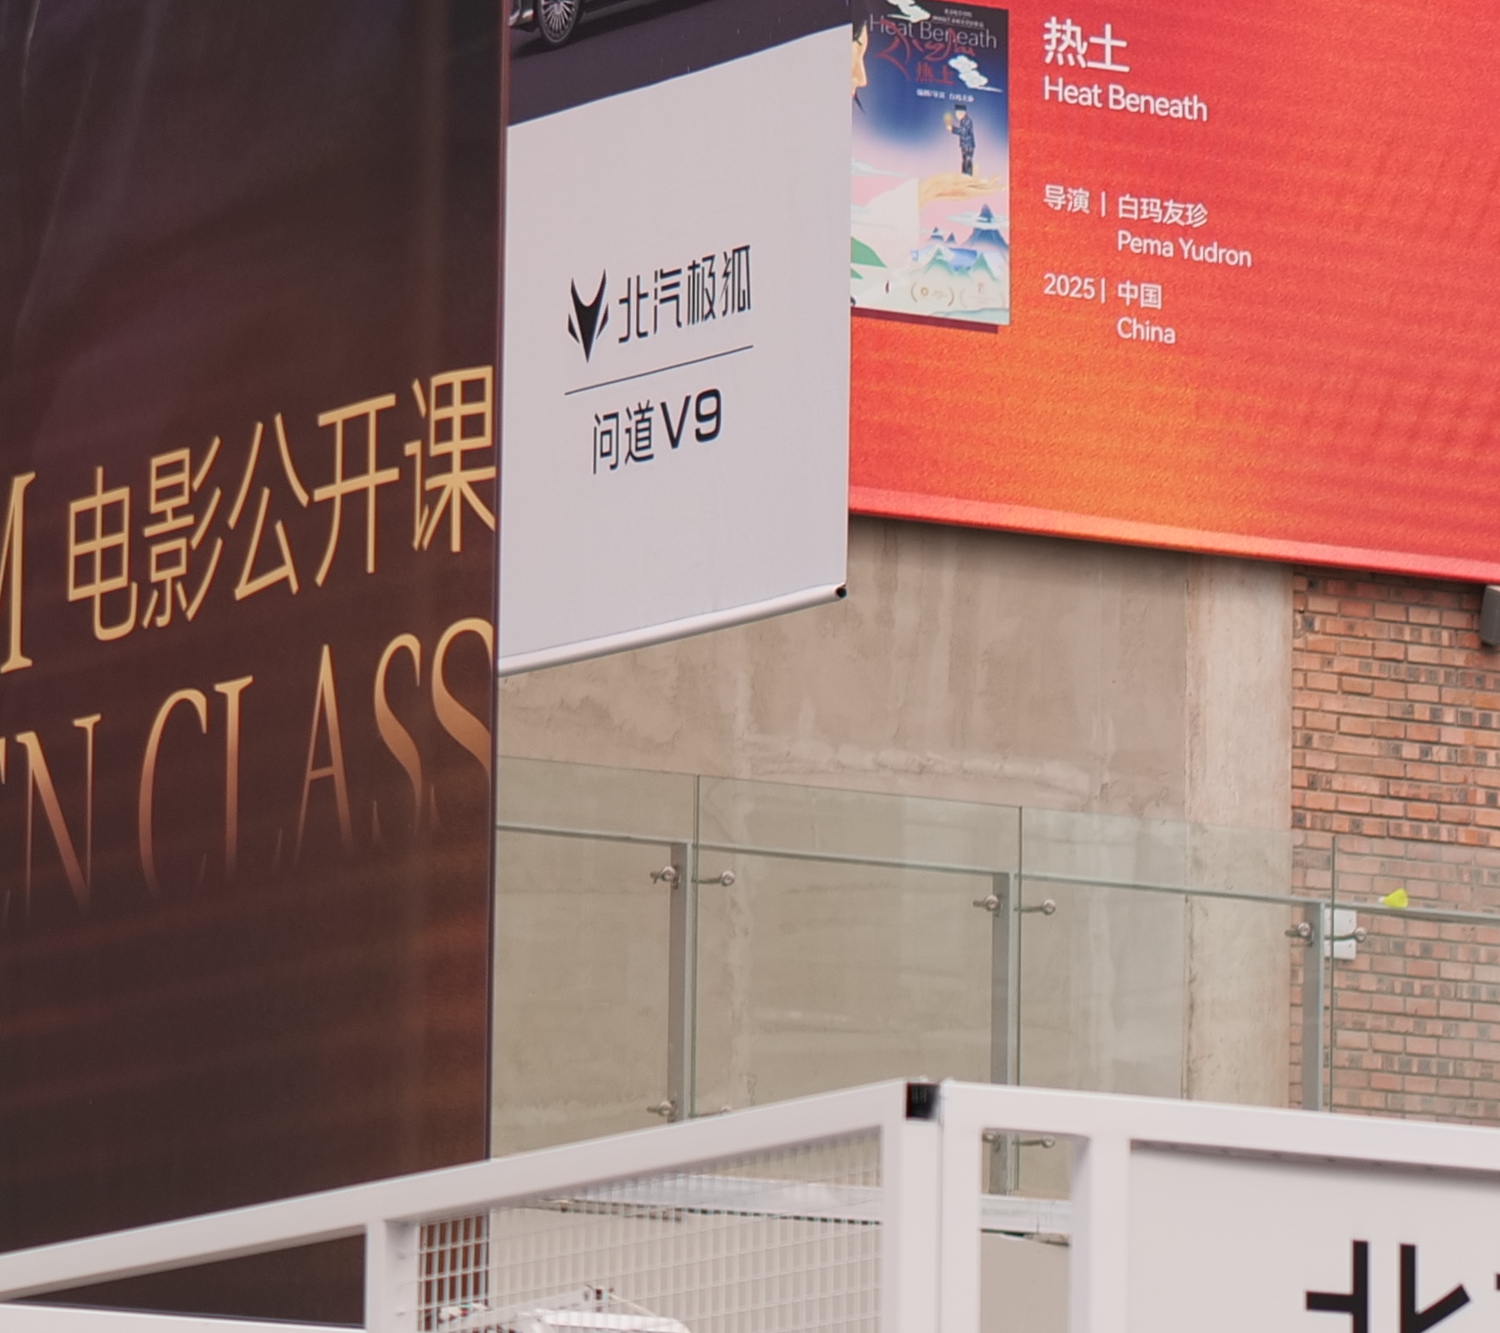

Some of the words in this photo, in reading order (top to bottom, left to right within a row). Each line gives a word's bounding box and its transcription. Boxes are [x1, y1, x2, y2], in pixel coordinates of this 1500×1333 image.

[1042, 17, 1132, 76] 热土
[1043, 75, 1101, 110] Heat
[1108, 81, 1209, 122] Beneath
[1043, 184, 1091, 216] 导演
[1117, 193, 1209, 229] 白玛友珍
[1117, 230, 1174, 261] Pema
[1179, 235, 1253, 269] Yudron
[618, 244, 752, 345] 北汽极狐
[1043, 273, 1096, 302] 2025
[1116, 281, 1163, 311] 中国
[1116, 314, 1176, 345] China
[68, 365, 496, 642] 电影公开课
